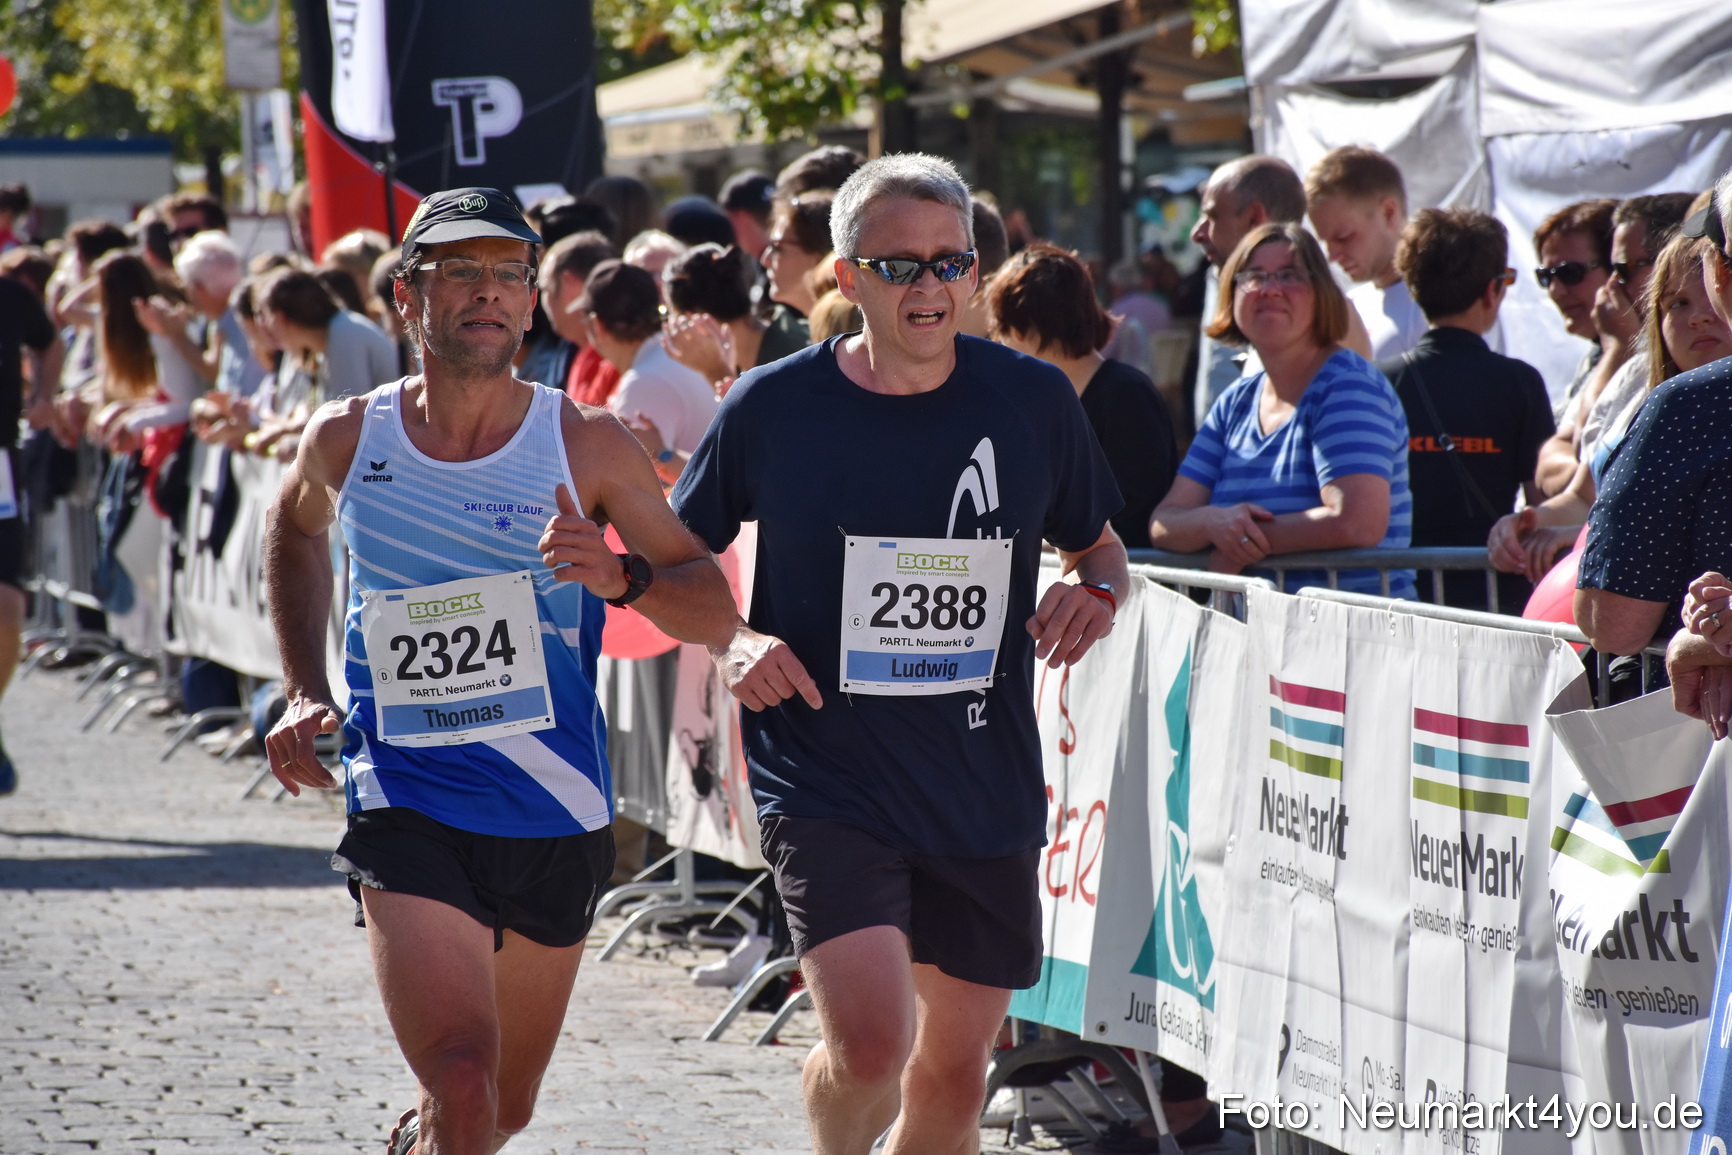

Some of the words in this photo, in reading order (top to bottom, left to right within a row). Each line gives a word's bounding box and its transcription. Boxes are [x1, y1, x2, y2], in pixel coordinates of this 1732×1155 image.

[462, 196, 485, 211] Buff
[362, 473, 393, 483] erima
[463, 502, 514, 513] SKI-CLUB
[517, 505, 544, 516] LAUF
[897, 553, 970, 571] BOCK
[407, 592, 484, 619] BOCK
[869, 582, 987, 631] 2388
[409, 618, 433, 626] inspired
[442, 613, 459, 622] smart
[459, 609, 486, 618] concepts
[853, 617, 860, 627] C
[390, 618, 517, 681] 2324
[879, 637, 914, 647] PARTL
[916, 638, 962, 648] Neumarkt
[381, 671, 388, 681] D
[891, 658, 959, 680] Ludwig
[409, 688, 444, 698] PARTL
[445, 679, 497, 695] Neumarkt
[423, 702, 505, 728] Thomas
[1413, 903, 1451, 937] einkaufen
[1572, 976, 1608, 1010] leben
[1616, 985, 1699, 1017] genießen
[1124, 992, 1157, 1028] Jura
